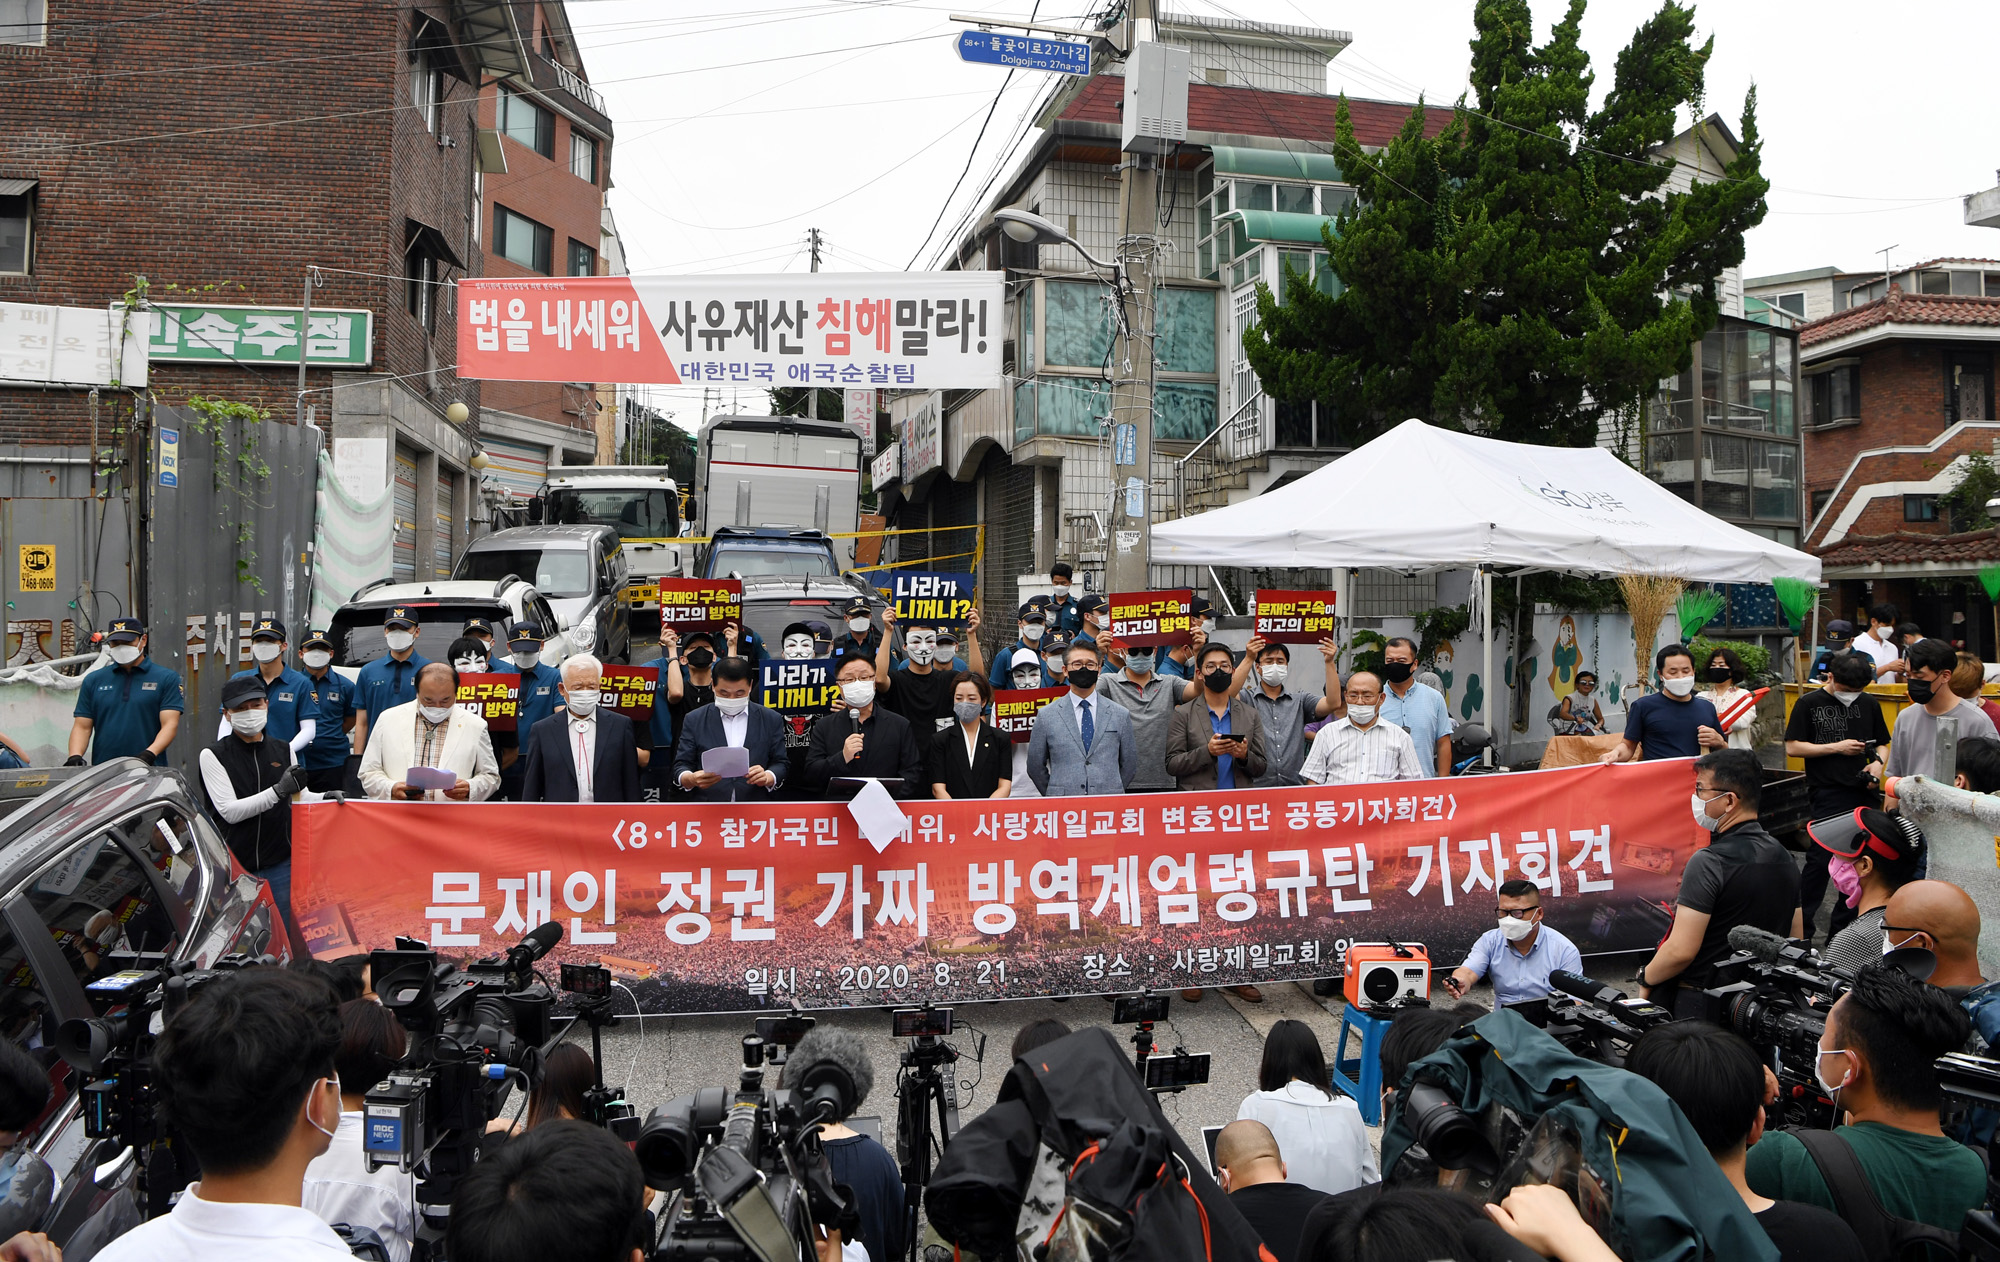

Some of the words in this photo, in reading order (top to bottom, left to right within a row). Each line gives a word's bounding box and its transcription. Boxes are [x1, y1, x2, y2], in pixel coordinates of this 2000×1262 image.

[989, 36, 1087, 62] 돌곶이로27나길
[1001, 54, 1047, 68] Dolgoji-ro
[1050, 60, 1086, 73] 27na-gil
[469, 298, 533, 352] 법을
[541, 299, 640, 352] 내세워
[660, 299, 809, 355] 사유재산
[816, 297, 988, 356] 침해말라!
[680, 361, 776, 382] 대한민국
[787, 362, 916, 384] 애국순찰팀
[26, 553, 47, 567] 인력
[896, 576, 957, 597] 나라가
[662, 590, 698, 605] 문재인
[700, 589, 741, 605] 구속이
[662, 606, 706, 622] 최고의
[709, 605, 740, 621] 방역
[896, 599, 971, 620] 니꺼냐?
[1111, 603, 1150, 620] 문재인
[1151, 600, 1190, 615] 구속이
[1257, 602, 1296, 616] 문재인
[1297, 600, 1335, 615] 구속이
[1112, 617, 1157, 637] 최고의
[1159, 616, 1190, 634] 방역
[1257, 617, 1301, 633] 최고의
[1304, 616, 1333, 632] 방역
[613, 676, 656, 692] 구속이
[764, 664, 827, 687] 나라가
[476, 683, 518, 700] 구속이
[620, 693, 654, 708] 방역
[763, 685, 841, 709] 니꺼냐?
[485, 701, 517, 718] 방역
[997, 701, 1035, 717] 문재인
[719, 816, 839, 849] 참가국민
[972, 808, 1146, 842] 사랑제일교회
[1161, 800, 1271, 836] 변호인단
[424, 868, 618, 947] 문재인
[656, 866, 776, 945] 정권
[813, 862, 935, 940] 가짜
[967, 842, 1375, 936] 방역계엄령규탄
[1407, 824, 1614, 908] 기자회견
[1082, 953, 1132, 981] 장소
[1149, 954, 1155, 973] :
[1171, 940, 1320, 974] 사랑제일교회
[744, 966, 796, 996] 일시
[815, 969, 822, 990] :
[839, 964, 919, 991] 2020.
[934, 961, 960, 987] 8.
[976, 959, 1019, 985] 21.
